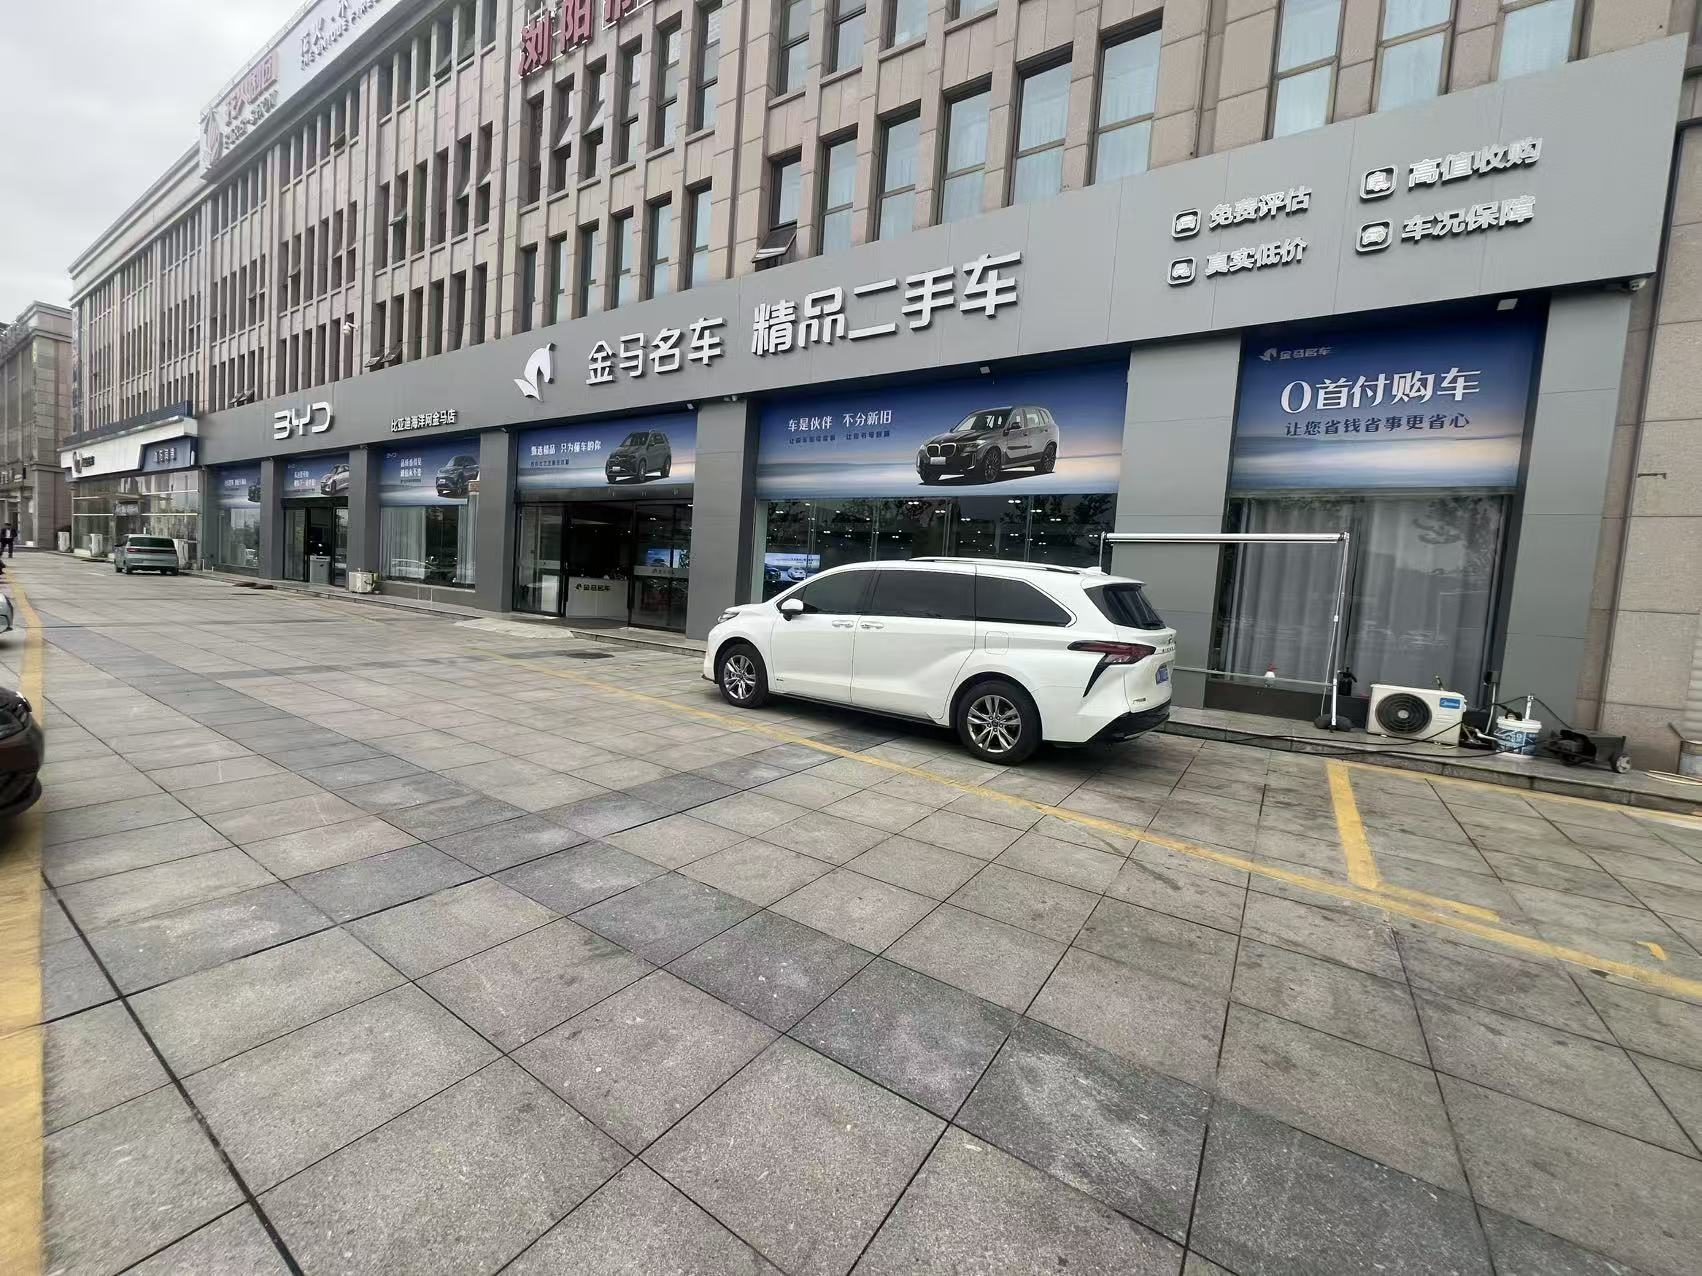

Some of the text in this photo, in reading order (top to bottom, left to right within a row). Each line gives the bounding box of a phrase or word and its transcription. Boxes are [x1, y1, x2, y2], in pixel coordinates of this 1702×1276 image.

[1408, 137, 1543, 188] 高值收购
[1209, 186, 1312, 229] 免费评估
[1402, 195, 1536, 241] 车况保障
[1204, 236, 1309, 278] 真实低价
[586, 251, 1023, 385] 金马名车 精品二手车
[1280, 367, 1482, 414] 0首付购车
[391, 409, 456, 432] 比亚迪海洋网金马店
[788, 410, 893, 432] 车是伙伴 不分新旧
[1285, 412, 1470, 437] 让您省钱省事更省心
